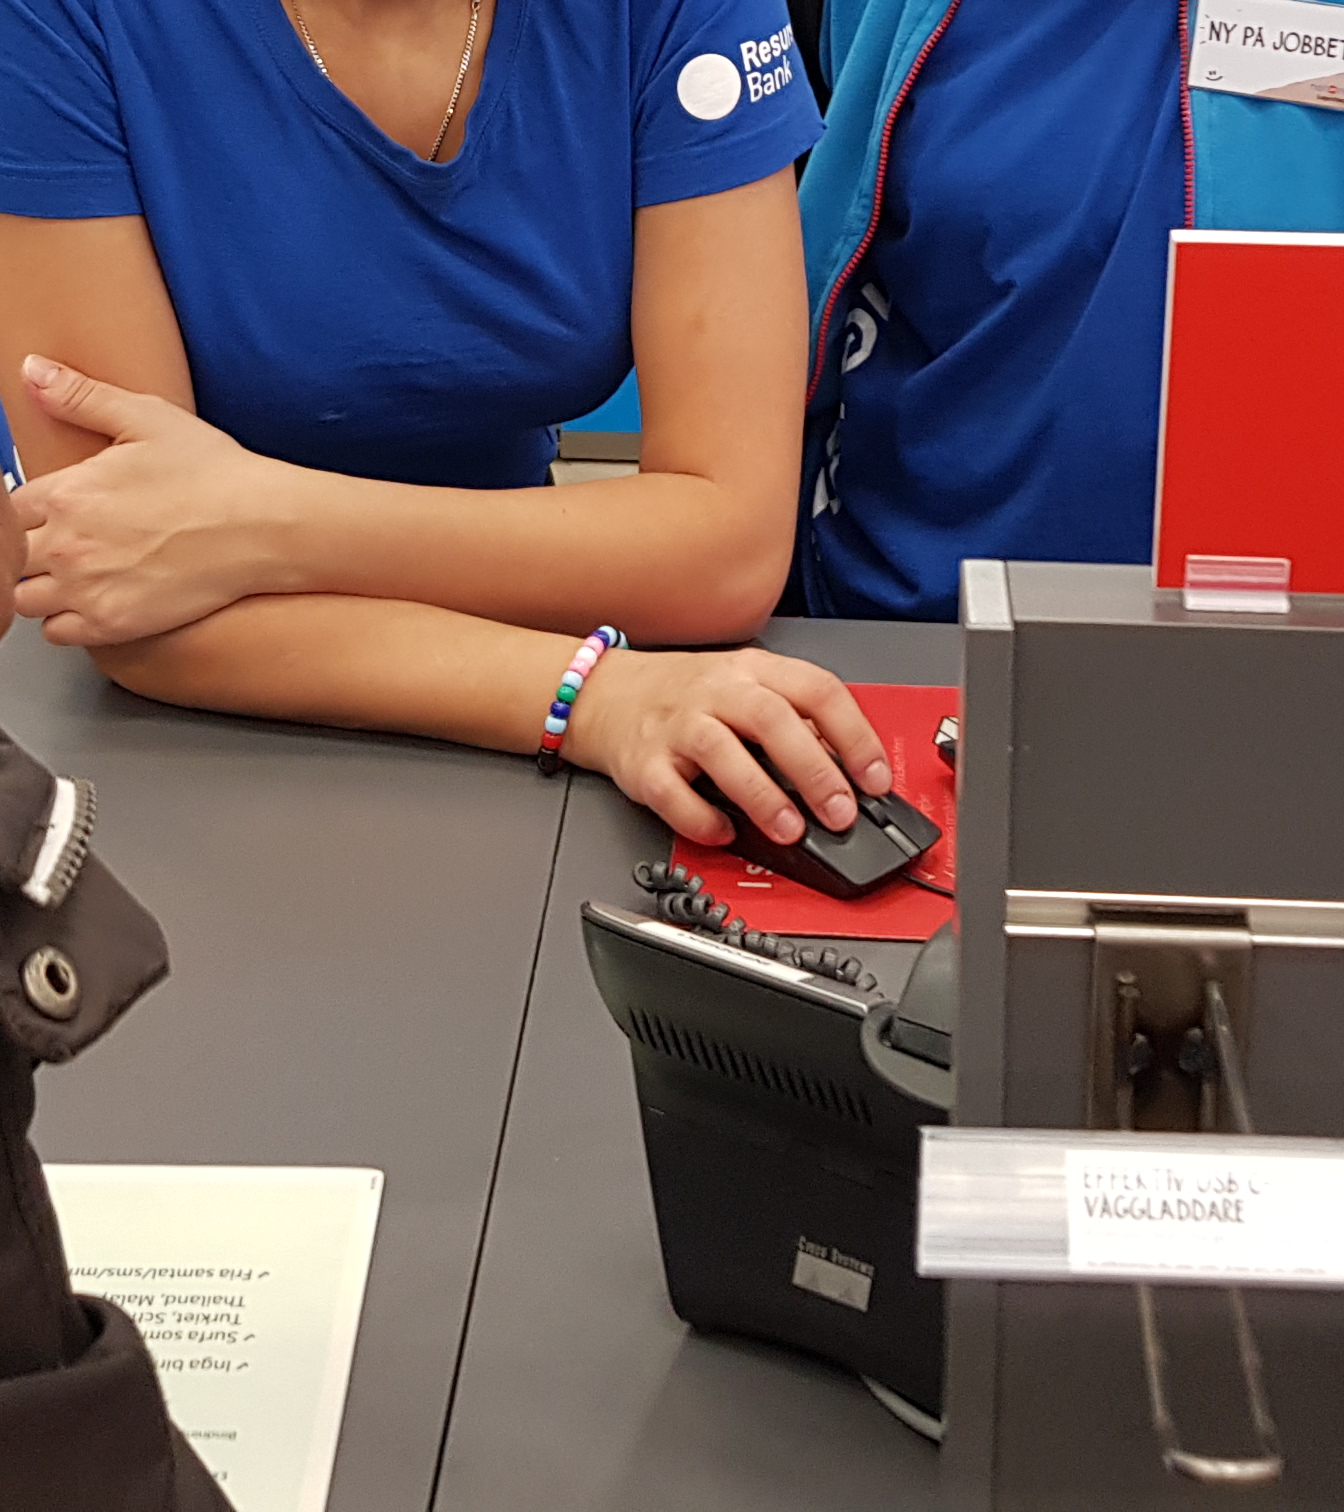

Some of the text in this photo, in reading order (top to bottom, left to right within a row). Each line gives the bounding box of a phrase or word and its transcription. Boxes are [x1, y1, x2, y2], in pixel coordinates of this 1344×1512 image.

[1209, 21, 1237, 43] NY
[1242, 26, 1265, 47] PÅ
[746, 55, 793, 102] Bank
